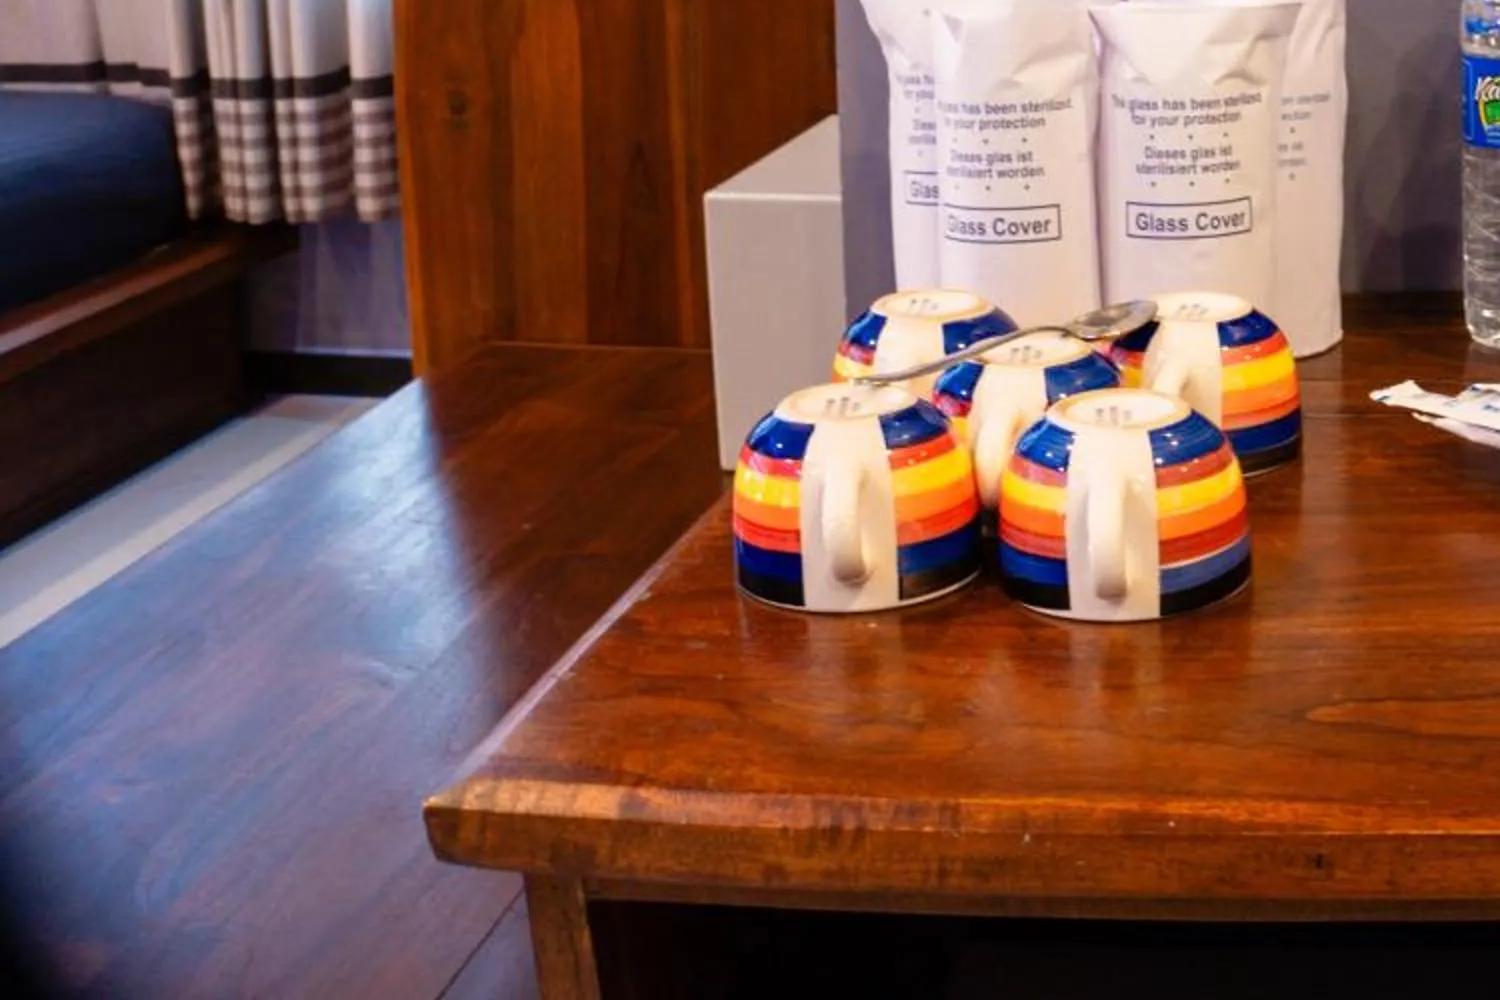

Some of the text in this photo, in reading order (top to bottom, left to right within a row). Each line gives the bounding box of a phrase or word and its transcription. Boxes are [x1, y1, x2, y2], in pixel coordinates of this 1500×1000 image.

[984, 103, 1017, 115] been
[1128, 99, 1159, 115] glass
[1161, 98, 1187, 111] has
[1190, 98, 1222, 111] been
[978, 116, 1046, 131] protection
[1150, 114, 1179, 128] your
[1182, 111, 1243, 128] protection
[985, 152, 1013, 167] glas
[1016, 149, 1033, 163] ist
[1144, 144, 1233, 164] Dieses glas ist
[996, 167, 1045, 179] worden
[1200, 160, 1242, 174] worden
[911, 181, 939, 199] Glas
[992, 217, 1052, 237] Cover
[1135, 211, 1247, 233] Glass Cover
